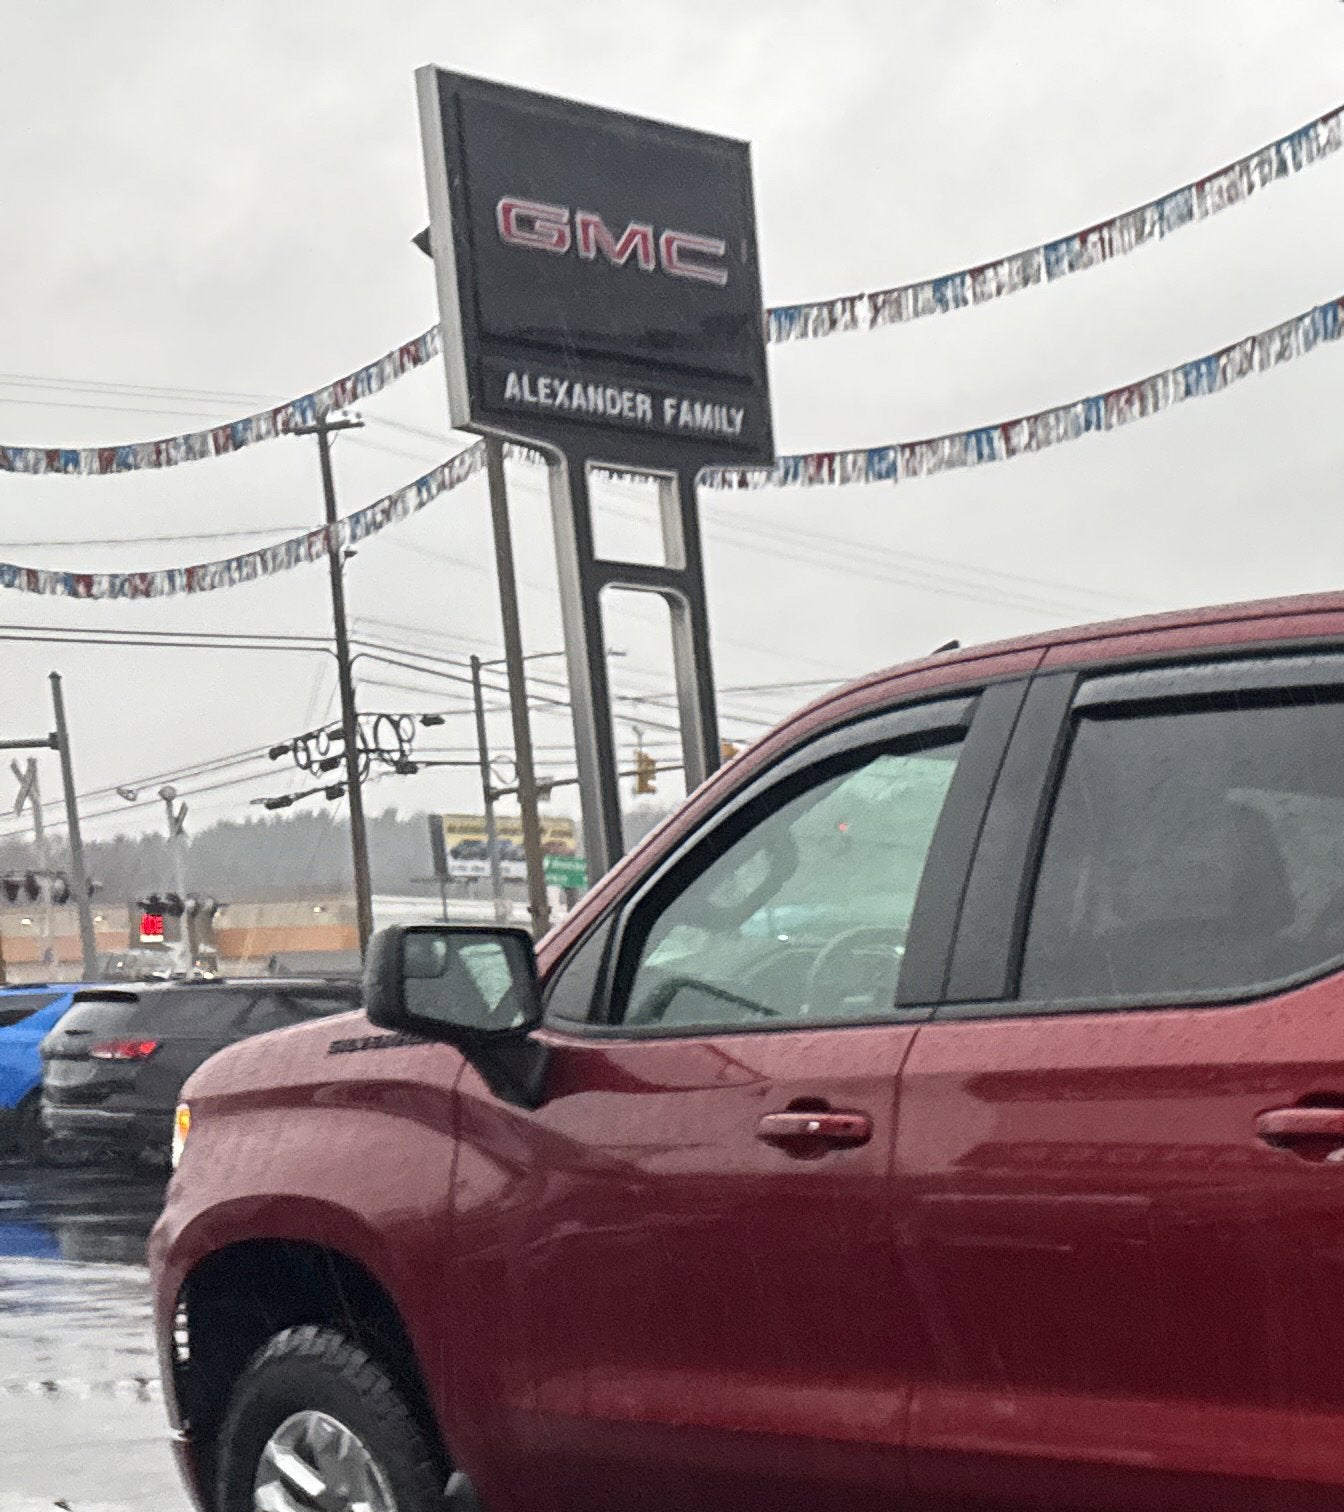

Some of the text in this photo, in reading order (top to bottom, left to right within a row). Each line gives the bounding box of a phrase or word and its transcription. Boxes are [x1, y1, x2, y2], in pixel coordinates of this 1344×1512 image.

[497, 198, 728, 286] GMC
[505, 371, 744, 436] ALEXANDER FAMILY
